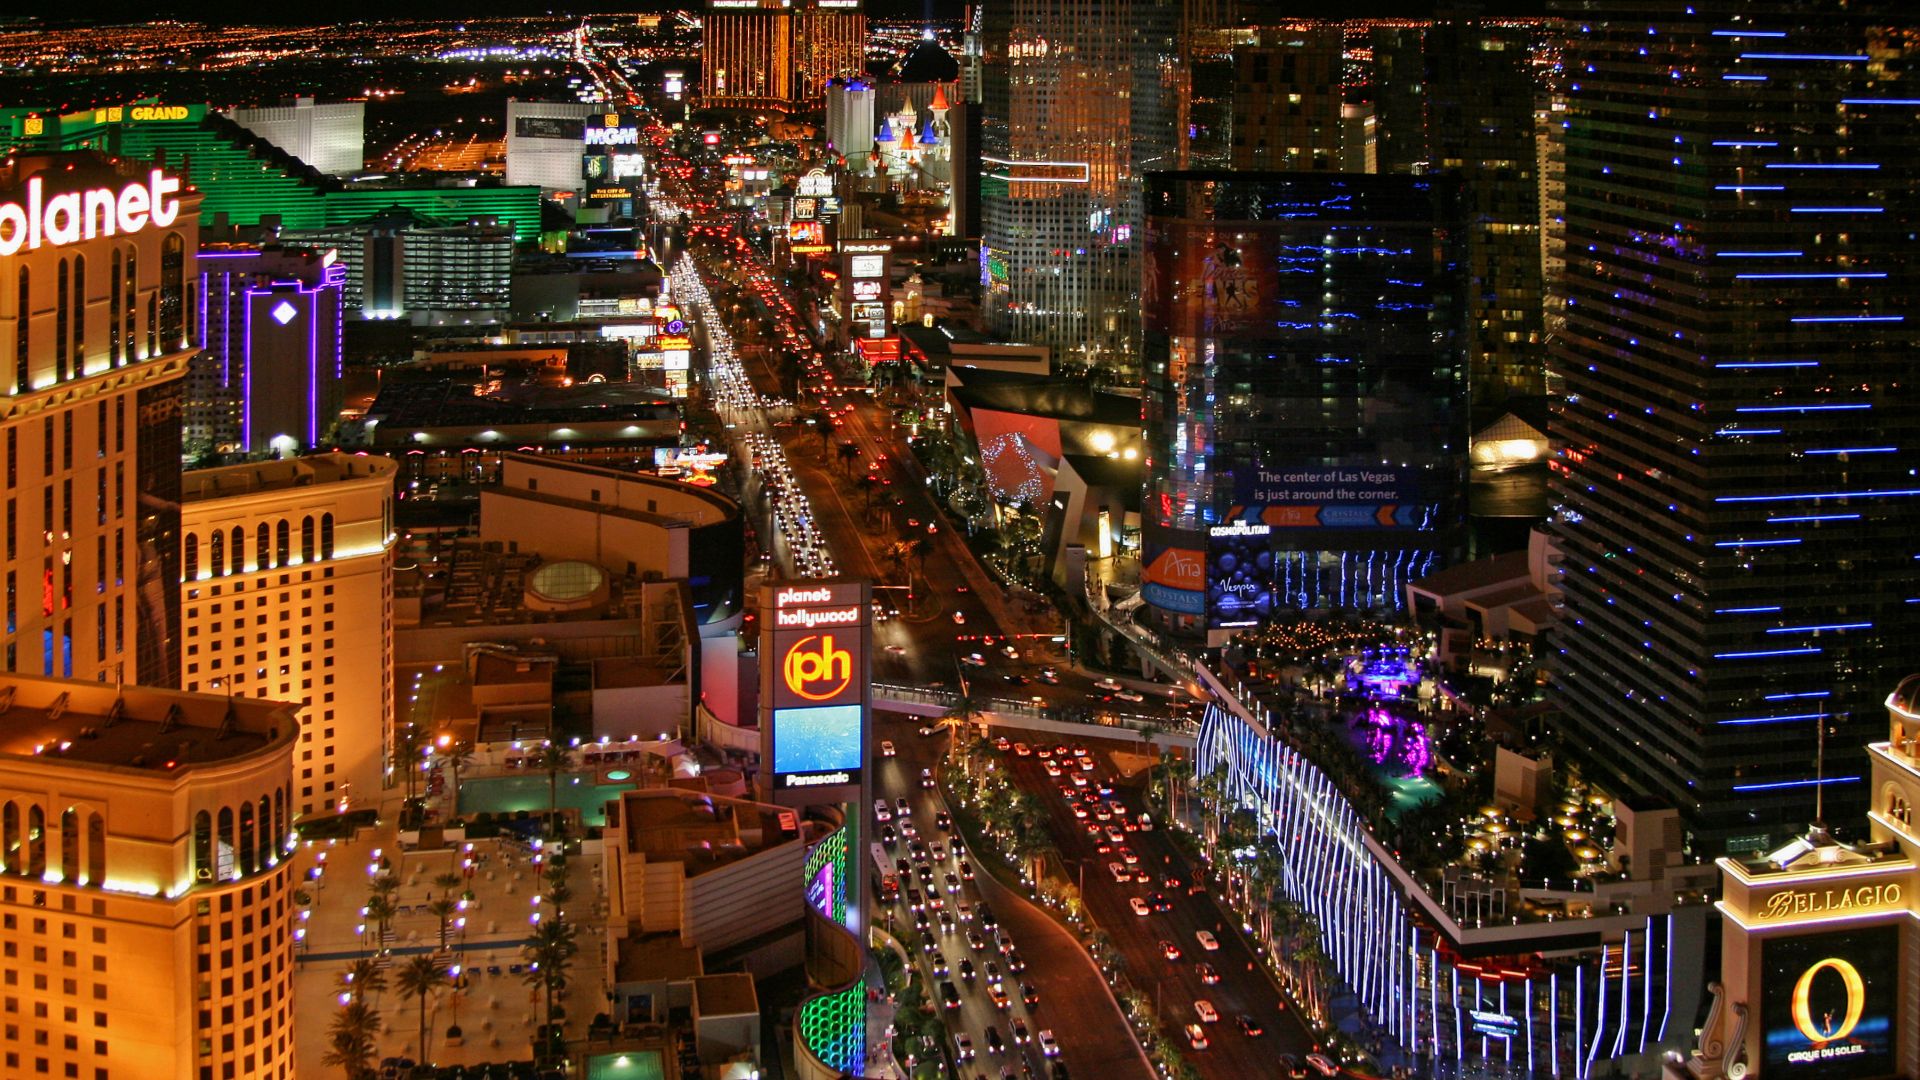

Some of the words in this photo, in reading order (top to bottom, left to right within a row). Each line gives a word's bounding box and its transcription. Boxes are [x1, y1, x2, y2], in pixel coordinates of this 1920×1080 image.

[131, 107, 188, 120] GRAND
[586, 127, 638, 145] MGM
[1257, 471, 1281, 482] The
[1283, 472, 1321, 482] center
[1323, 471, 1336, 482] of
[1339, 472, 1358, 482] Las
[1360, 472, 1396, 485] Vegas
[1254, 489, 1265, 500] is
[1266, 489, 1290, 503] just
[1292, 488, 1334, 500] around
[1336, 488, 1356, 500] the
[1359, 490, 1400, 500] corner.
[1210, 525, 1270, 537] COSMOPOLITAN
[1233, 519, 1247, 527] THE
[1163, 552, 1201, 577] Aria
[778, 588, 831, 607] planet
[778, 608, 858, 627] hollywood
[792, 635, 851, 694] ph
[786, 772, 850, 787] Panasonic
[1758, 883, 1901, 919] BELLAGIO
[1791, 957, 1865, 1042] O
[1787, 1050, 1820, 1062] CIRQUE
[1821, 1048, 1834, 1058] DU
